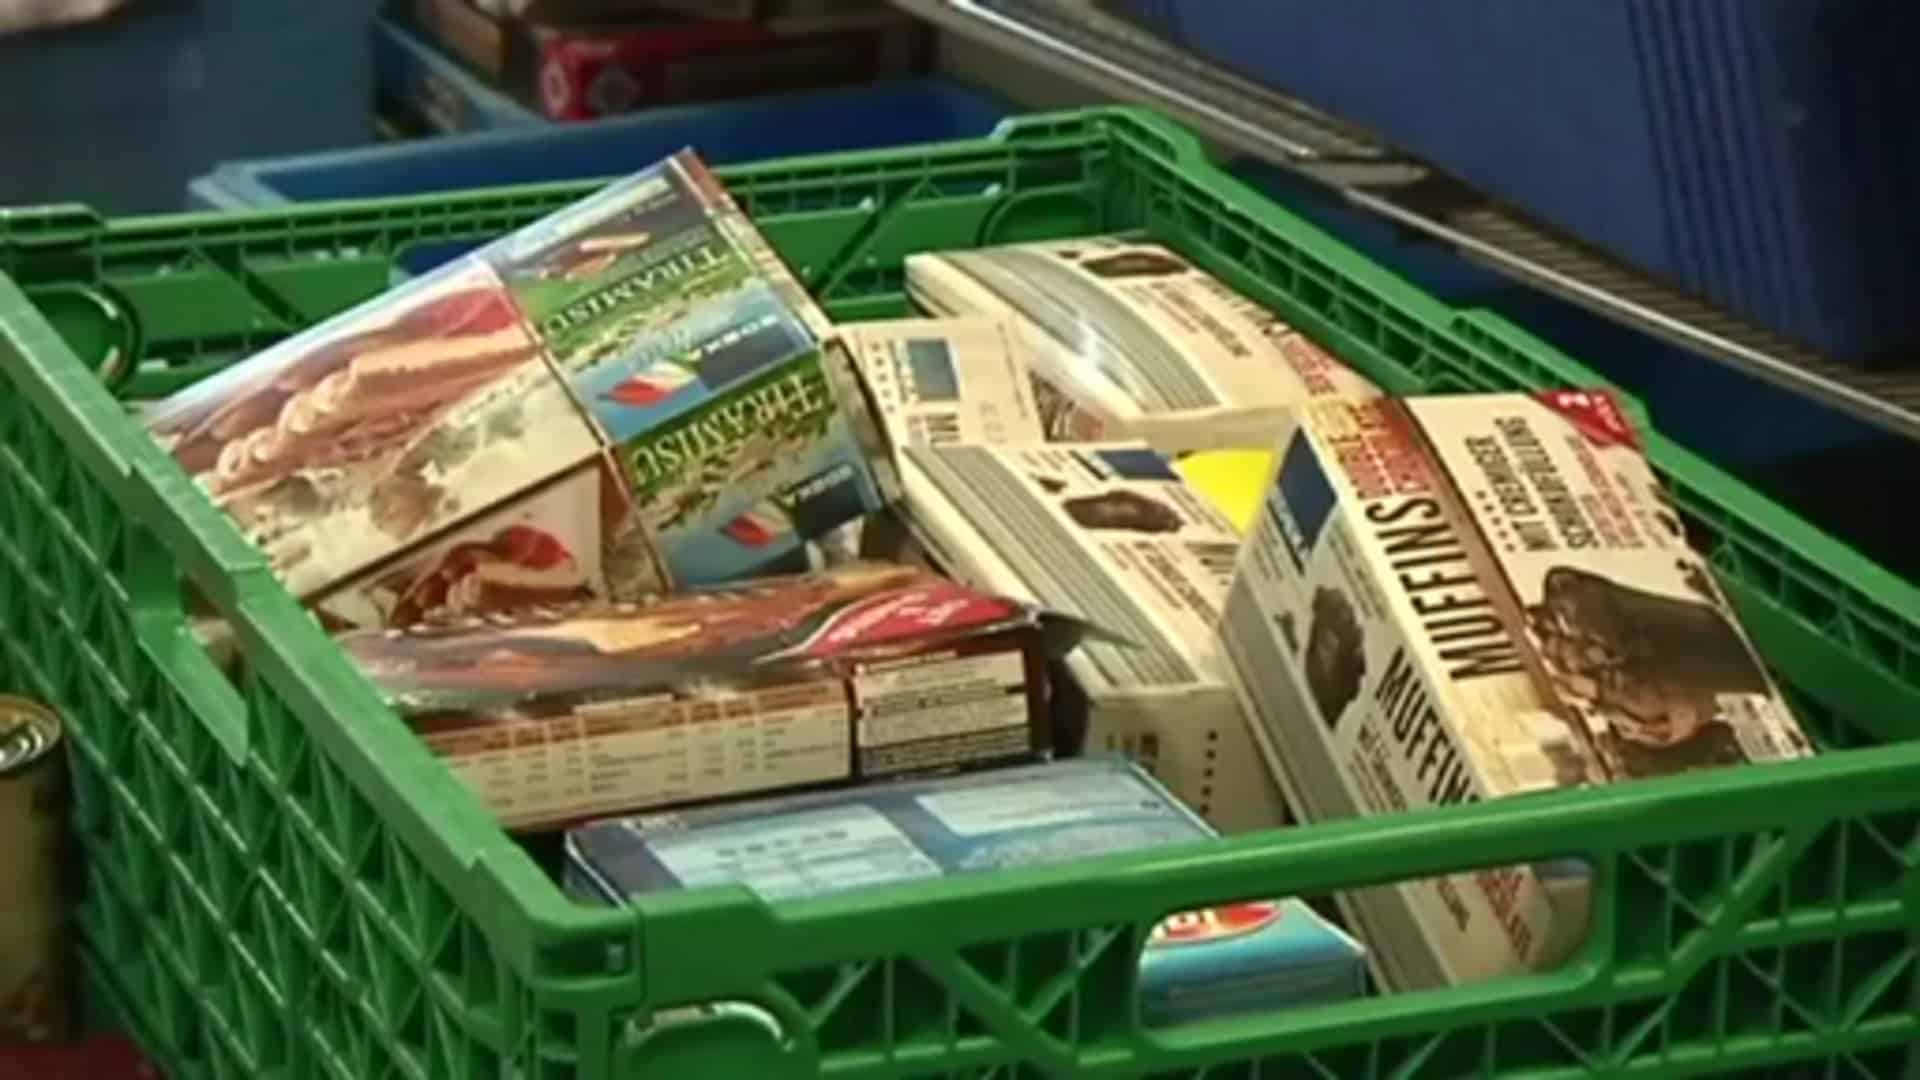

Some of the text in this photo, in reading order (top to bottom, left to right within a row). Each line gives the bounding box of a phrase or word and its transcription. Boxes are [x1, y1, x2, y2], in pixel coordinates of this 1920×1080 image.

[545, 244, 729, 335] TIRAMISU
[632, 375, 825, 485] TIRAMISU
[1364, 497, 1526, 679] MUFFINS
[1374, 645, 1481, 807] MUFFIN
